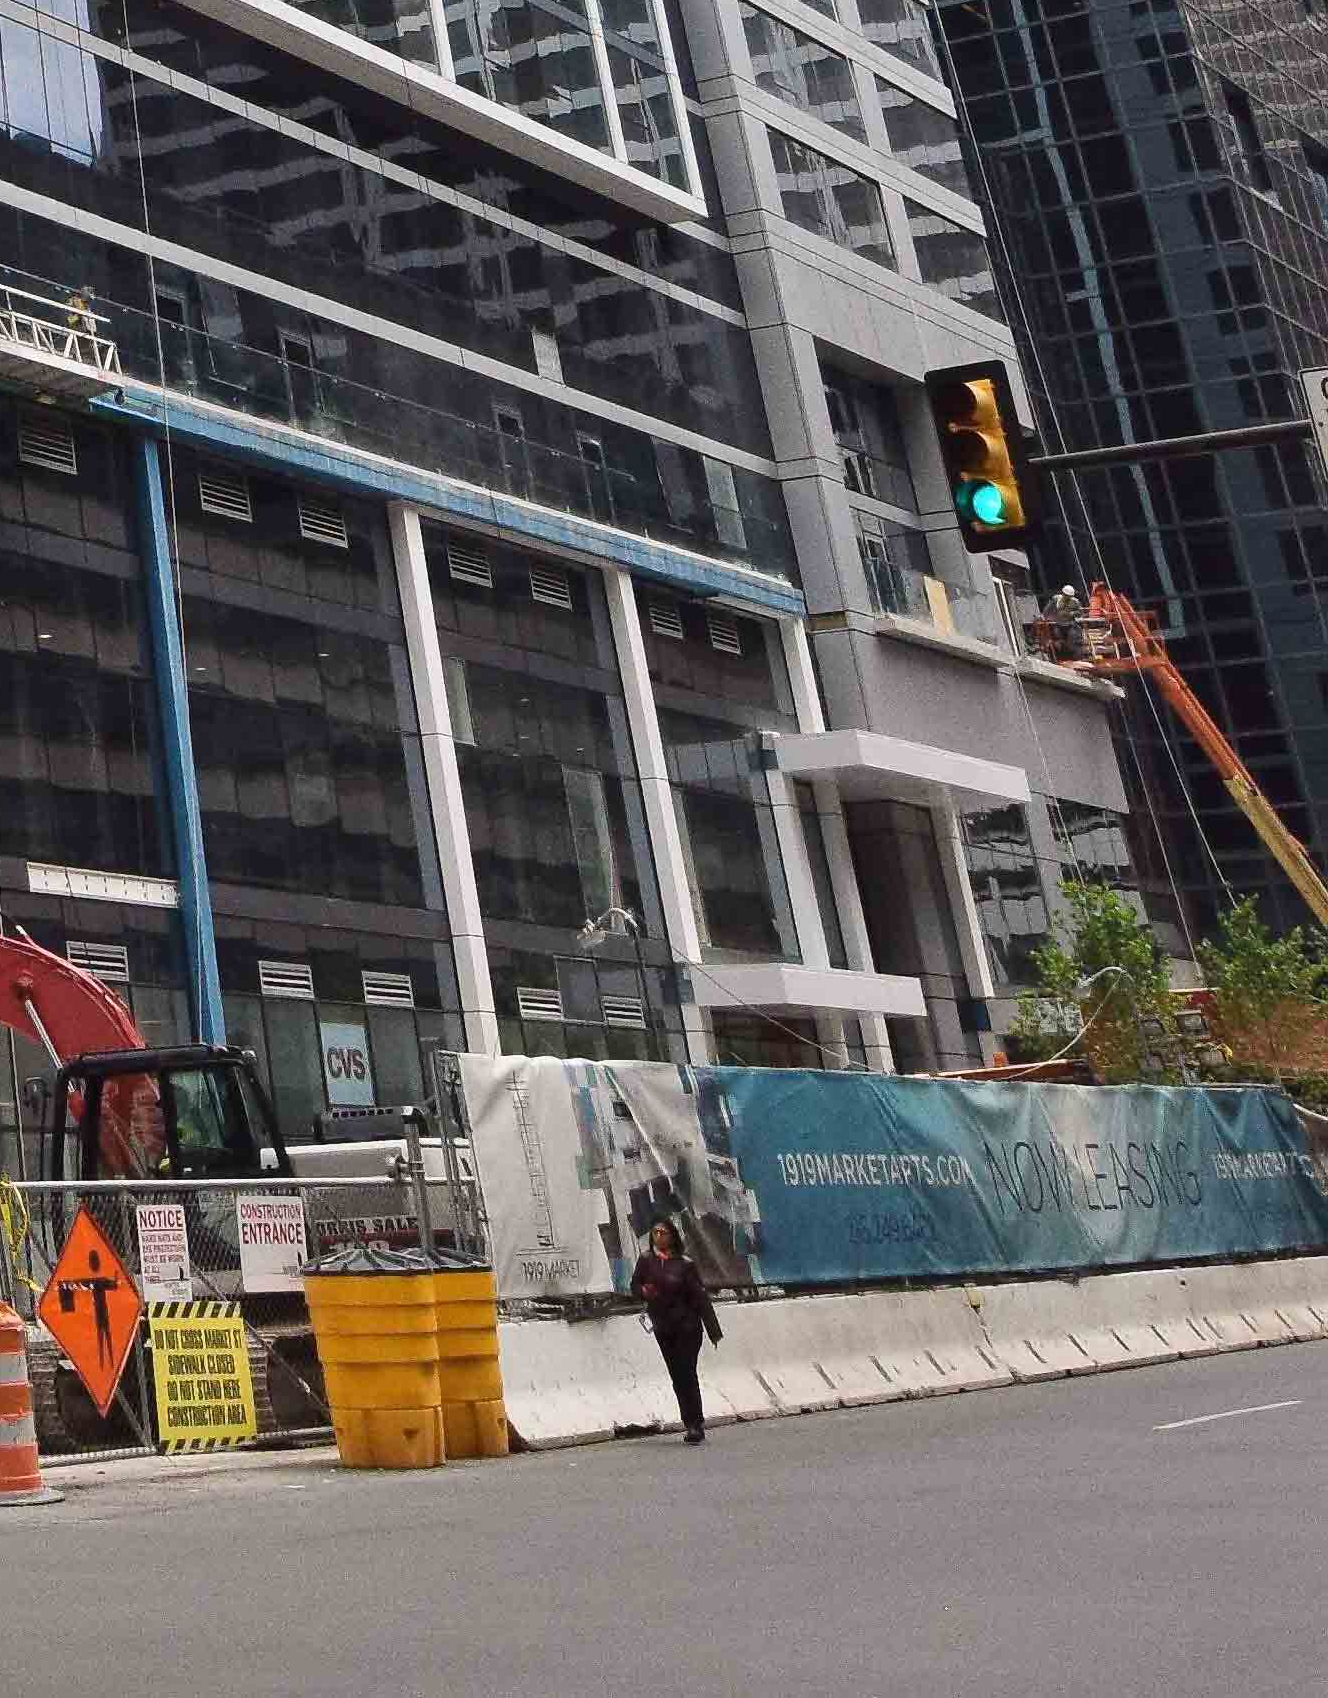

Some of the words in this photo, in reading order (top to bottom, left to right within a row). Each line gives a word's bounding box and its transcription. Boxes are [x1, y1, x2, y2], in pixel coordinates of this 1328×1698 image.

[326, 1047, 367, 1082] CVS
[1072, 1139, 1203, 1213] LEASING
[138, 1210, 184, 1228] NOTICE
[240, 1204, 302, 1219] CONSTRUCTION
[241, 1222, 304, 1245] ENTRANCE
[373, 1214, 420, 1234] SALE
[521, 1260, 544, 1282] 1919
[545, 1259, 580, 1281] MARKET
[154, 1329, 164, 1350] DO
[165, 1329, 179, 1350] NOT
[180, 1329, 203, 1349] CROSS
[204, 1329, 232, 1349] MARKET
[233, 1328, 243, 1348] ST
[168, 1354, 206, 1375] SIDEWALK
[207, 1354, 235, 1374] CLOSED
[167, 1380, 178, 1401] DO
[179, 1380, 195, 1401] NOT
[197, 1380, 222, 1400] STAND
[223, 1379, 242, 1399] HERE
[168, 1405, 226, 1427] CONSTRUCTION
[227, 1404, 247, 1425] AREA
